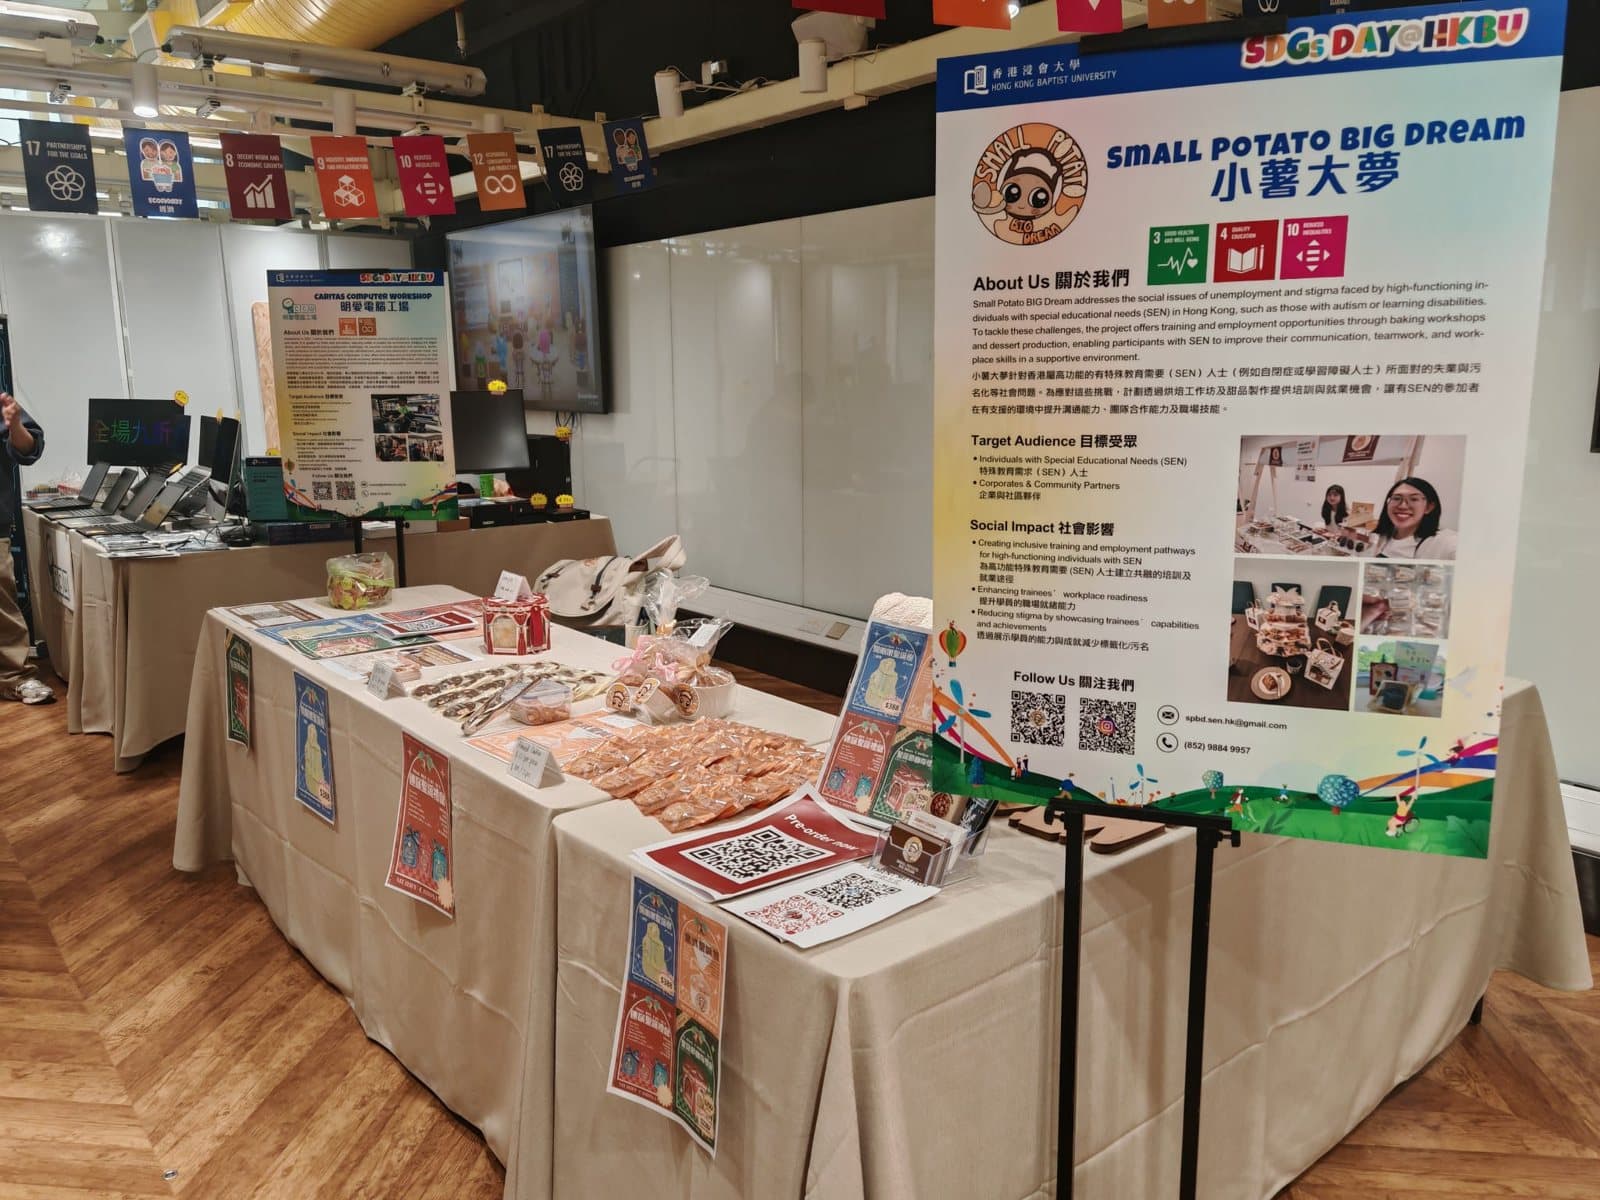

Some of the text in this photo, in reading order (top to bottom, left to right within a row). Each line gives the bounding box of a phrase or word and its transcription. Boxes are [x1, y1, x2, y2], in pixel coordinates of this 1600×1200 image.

[1243, 11, 1526, 67] SDGs DAY@HKBU
[992, 58, 1081, 80] 香港浸會大學
[992, 70, 1117, 92] HONG KONG BAPTIST UNIVERSITY
[25, 141, 41, 156] 17
[1211, 129, 1332, 162] POTATO
[1340, 123, 1395, 151] BIG
[544, 146, 554, 158] 17
[226, 154, 234, 167] 8
[317, 157, 325, 170] 9
[400, 155, 412, 168] 10
[473, 154, 485, 165] 12
[976, 125, 1088, 198] SMALL POTATO
[1210, 152, 1401, 202] 小薯大夢
[1023, 224, 1062, 245] DREAM
[1220, 228, 1228, 240] 4
[1288, 223, 1299, 236] 10
[1153, 232, 1160, 244] 3
[973, 269, 1130, 291] About Us 關於我們
[973, 299, 996, 308] Small
[997, 298, 1025, 308] Potato
[1025, 296, 1043, 307] BIG
[1044, 297, 1073, 306] Dream
[1074, 296, 1120, 304] addresses
[1122, 294, 1136, 303] the
[1137, 293, 1165, 302] social
[1166, 293, 1197, 301] issues
[1198, 291, 1208, 300] of
[1210, 290, 1282, 300] unemployment
[1284, 288, 1303, 296] and
[1304, 287, 1339, 297] stigma
[1341, 285, 1370, 294] faced
[1371, 284, 1384, 294] by
[1386, 282, 1472, 294] high-functioning
[340, 301, 409, 312] 明愛電腦工場
[972, 356, 994, 365] place
[996, 355, 1017, 363] skills
[1018, 355, 1027, 363] in
[1036, 355, 1080, 364] supportive
[1082, 354, 1140, 362] environment.
[971, 434, 1137, 448] Target Audience 目標受眾
[1044, 456, 1075, 464] Special
[1077, 456, 1128, 464] Educational
[1130, 457, 1159, 465] Needs
[1160, 457, 1187, 467] (SEN)
[979, 467, 1088, 477] 特殊教育需求（SEN）人士
[979, 479, 1120, 490] Corporates & Community Partners
[970, 520, 1114, 536] Social Impact 社會影響
[978, 539, 1011, 549] Creating
[1012, 541, 1048, 549] inclusive
[1050, 542, 1080, 552] training
[1099, 545, 1152, 554] employment
[1154, 547, 1196, 556] pathways
[980, 550, 1142, 565] for high-functioning individuals with SEN
[1070, 567, 1094, 576] (SEN)
[977, 585, 1019, 596] Enhancing
[1063, 592, 1105, 600] workplace
[1106, 594, 1148, 602] readiness
[977, 608, 1014, 619] Reducing
[1015, 608, 1041, 621] stigma
[1043, 610, 1054, 622] by
[1056, 615, 1104, 625] showcasing
[1150, 621, 1200, 629] capabilities
[992, 622, 1047, 631] achievements
[1014, 671, 1134, 691] Follow Us 關注我們
[885, 702, 900, 711] $388
[1185, 716, 1288, 729] spbd.sen.hk@gmail.com
[1184, 741, 1251, 754] (852) 9884 9957
[784, 812, 860, 853] Pre-order now
